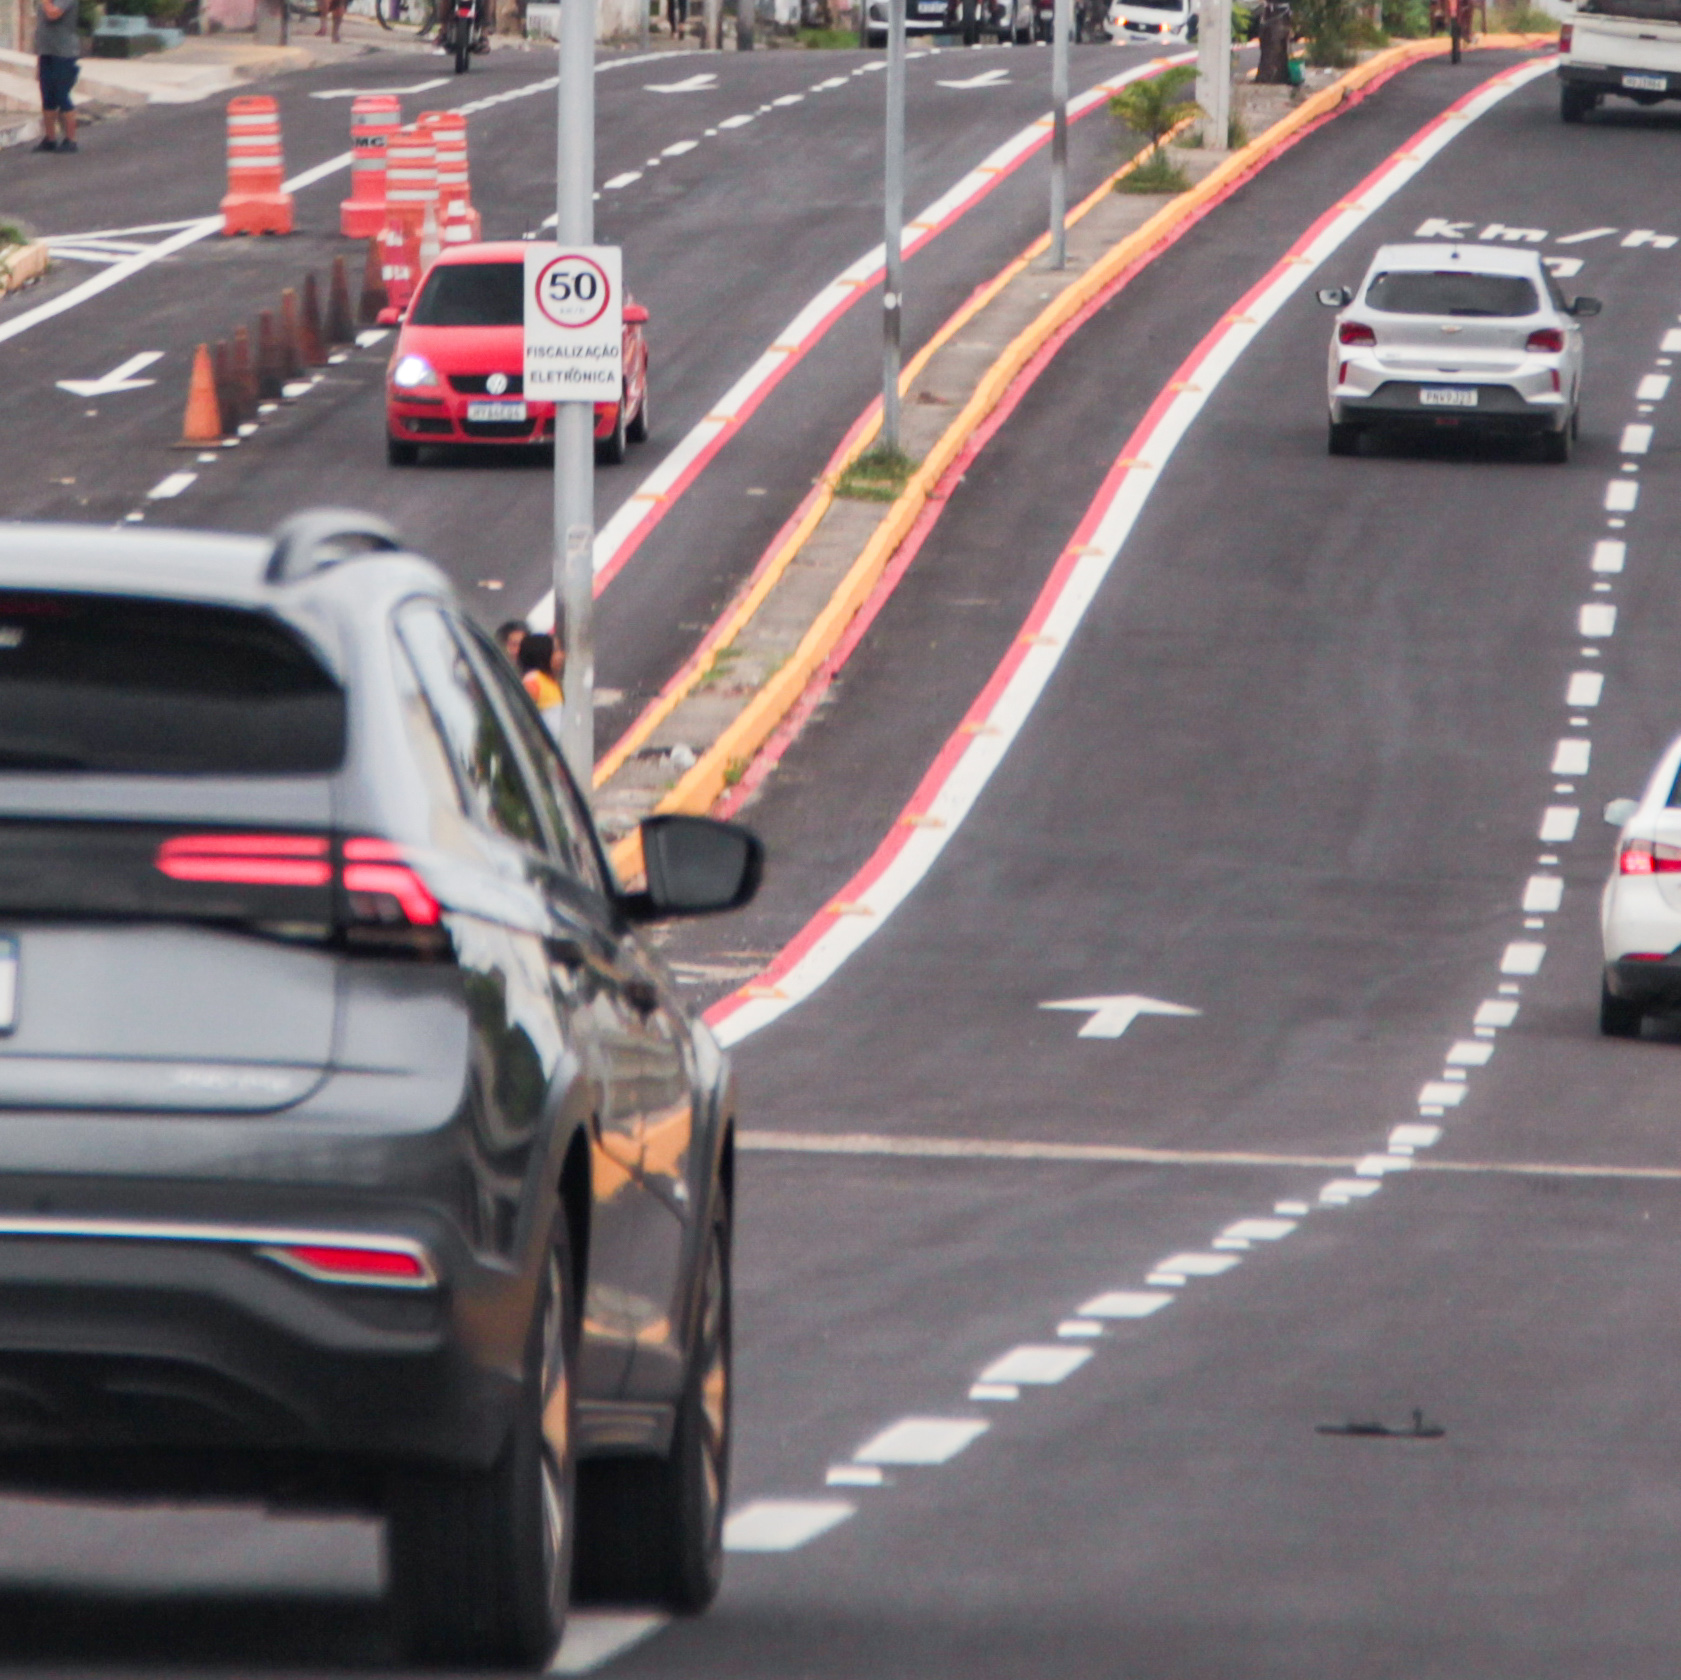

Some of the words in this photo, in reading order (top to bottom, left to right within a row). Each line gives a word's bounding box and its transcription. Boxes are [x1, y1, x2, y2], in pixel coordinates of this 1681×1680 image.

[549, 272, 597, 301] 50
[526, 344, 619, 361] FISCALIZAÇÃO
[530, 368, 615, 384] ELETRÔNICA
